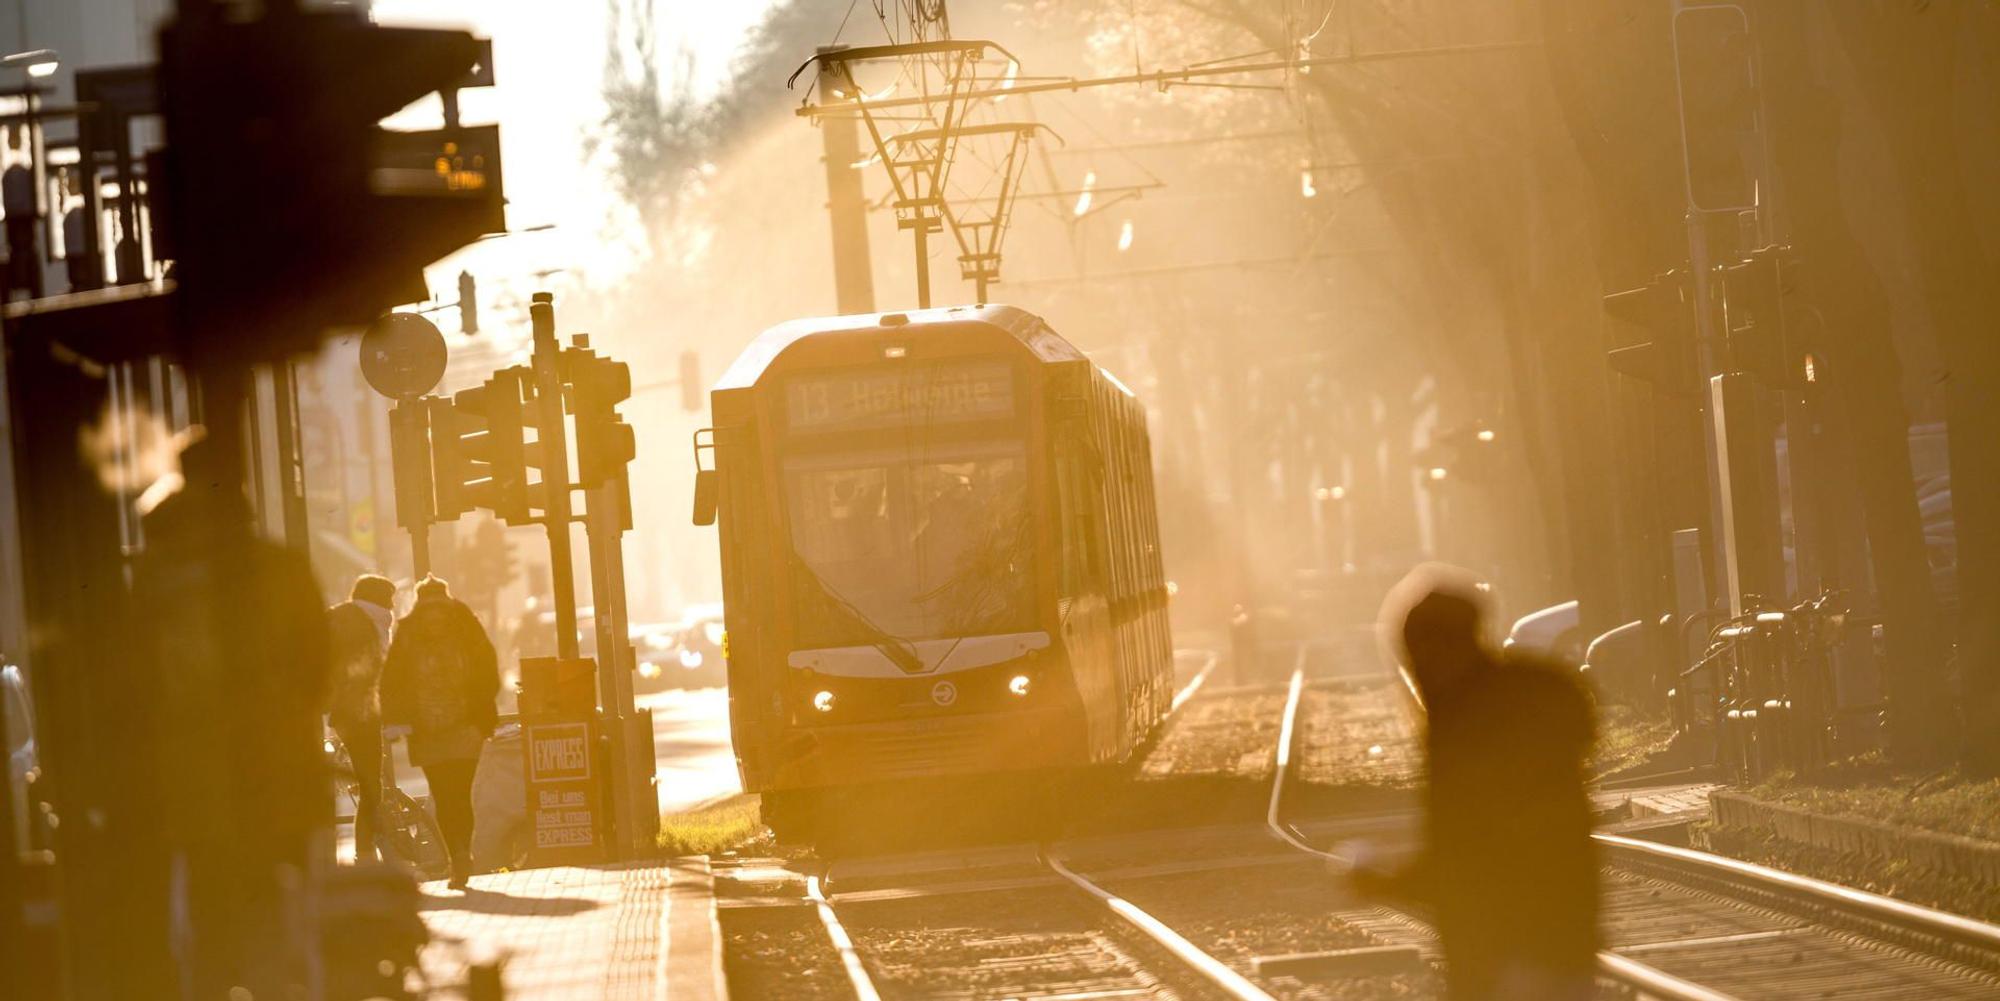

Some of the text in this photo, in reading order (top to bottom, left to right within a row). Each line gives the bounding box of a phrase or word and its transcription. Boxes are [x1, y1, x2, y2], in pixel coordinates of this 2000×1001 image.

[535, 738, 585, 770] EXPRESS
[540, 791, 585, 804] Bei uns
[565, 810, 592, 823] man
[536, 827, 593, 844] EXPRESS
